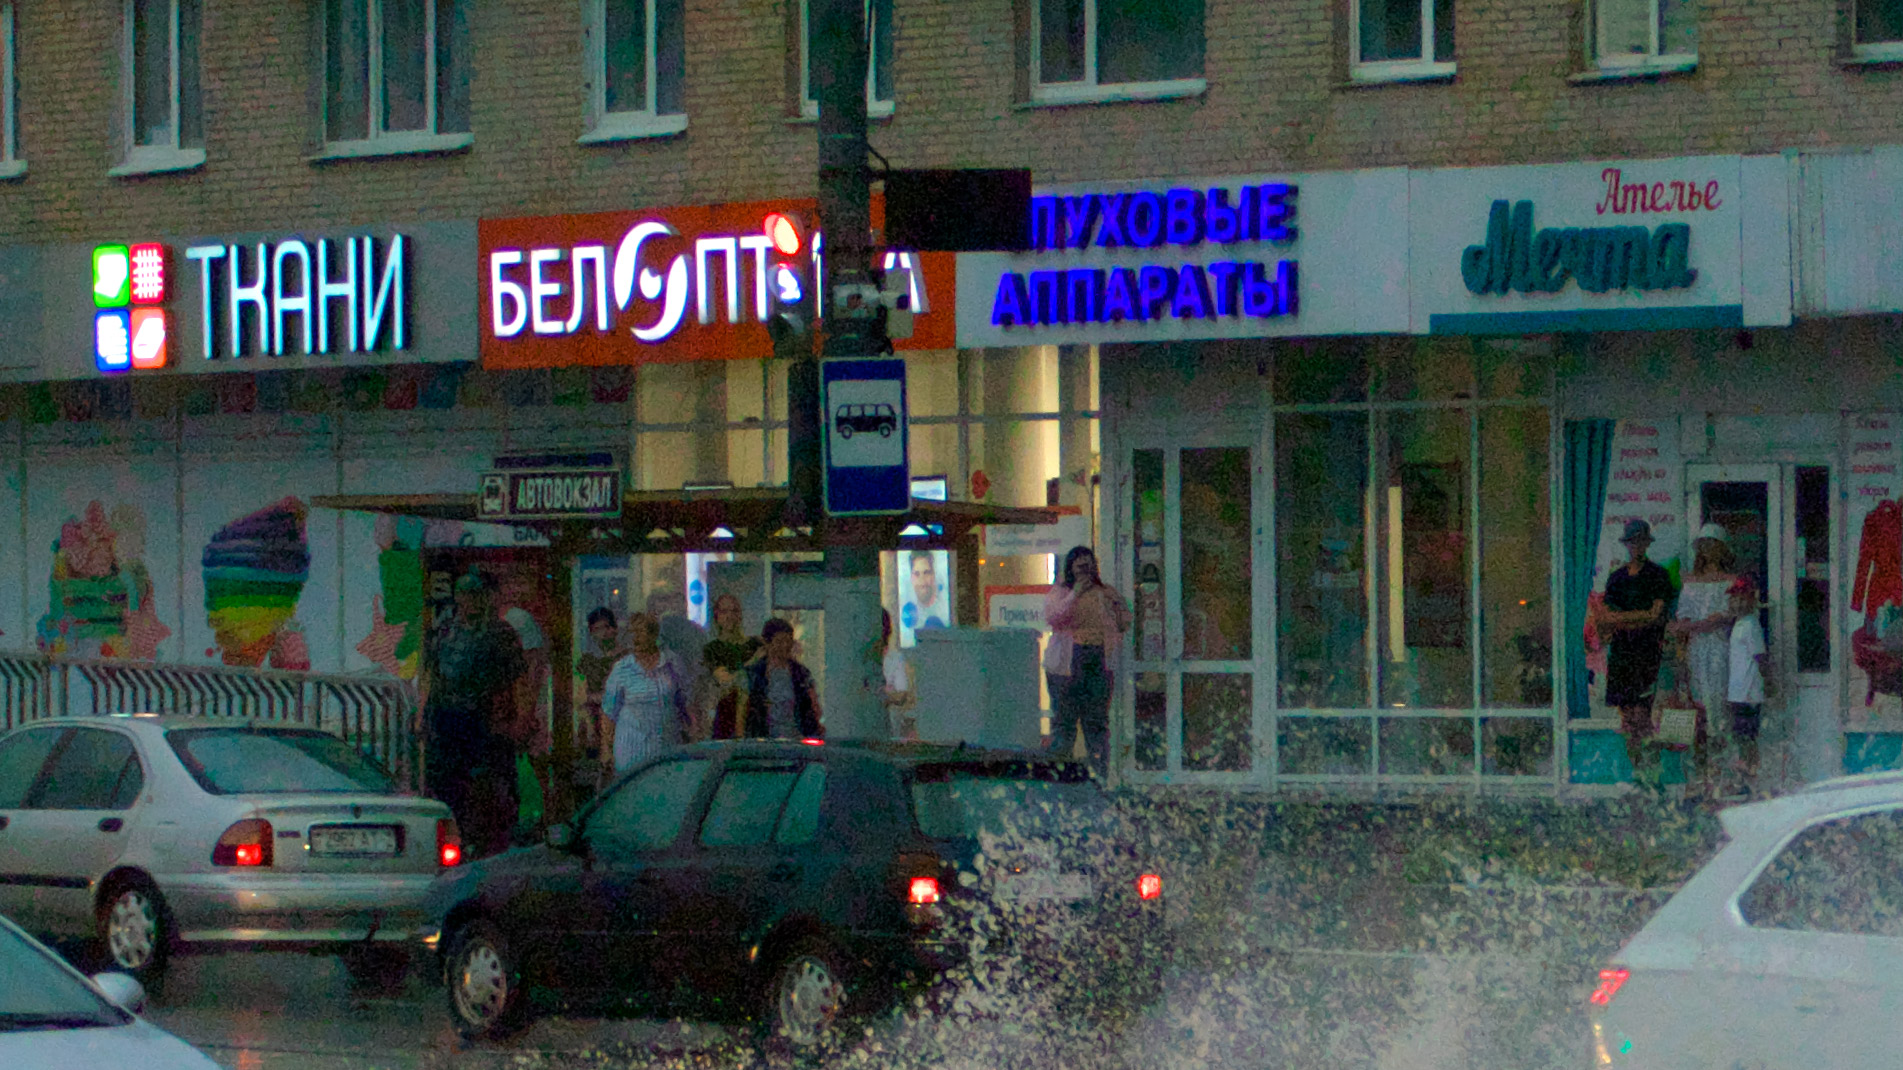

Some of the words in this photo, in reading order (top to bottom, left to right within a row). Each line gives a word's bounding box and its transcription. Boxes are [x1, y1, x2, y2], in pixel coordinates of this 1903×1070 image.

[1596, 167, 1722, 215] Ателье
[1461, 199, 1698, 297] Мечта
[186, 234, 405, 360] ТКАНИ
[991, 260, 1298, 326] АППАРАТЫ
[516, 475, 613, 510] АВТОВОКЗАЛ
